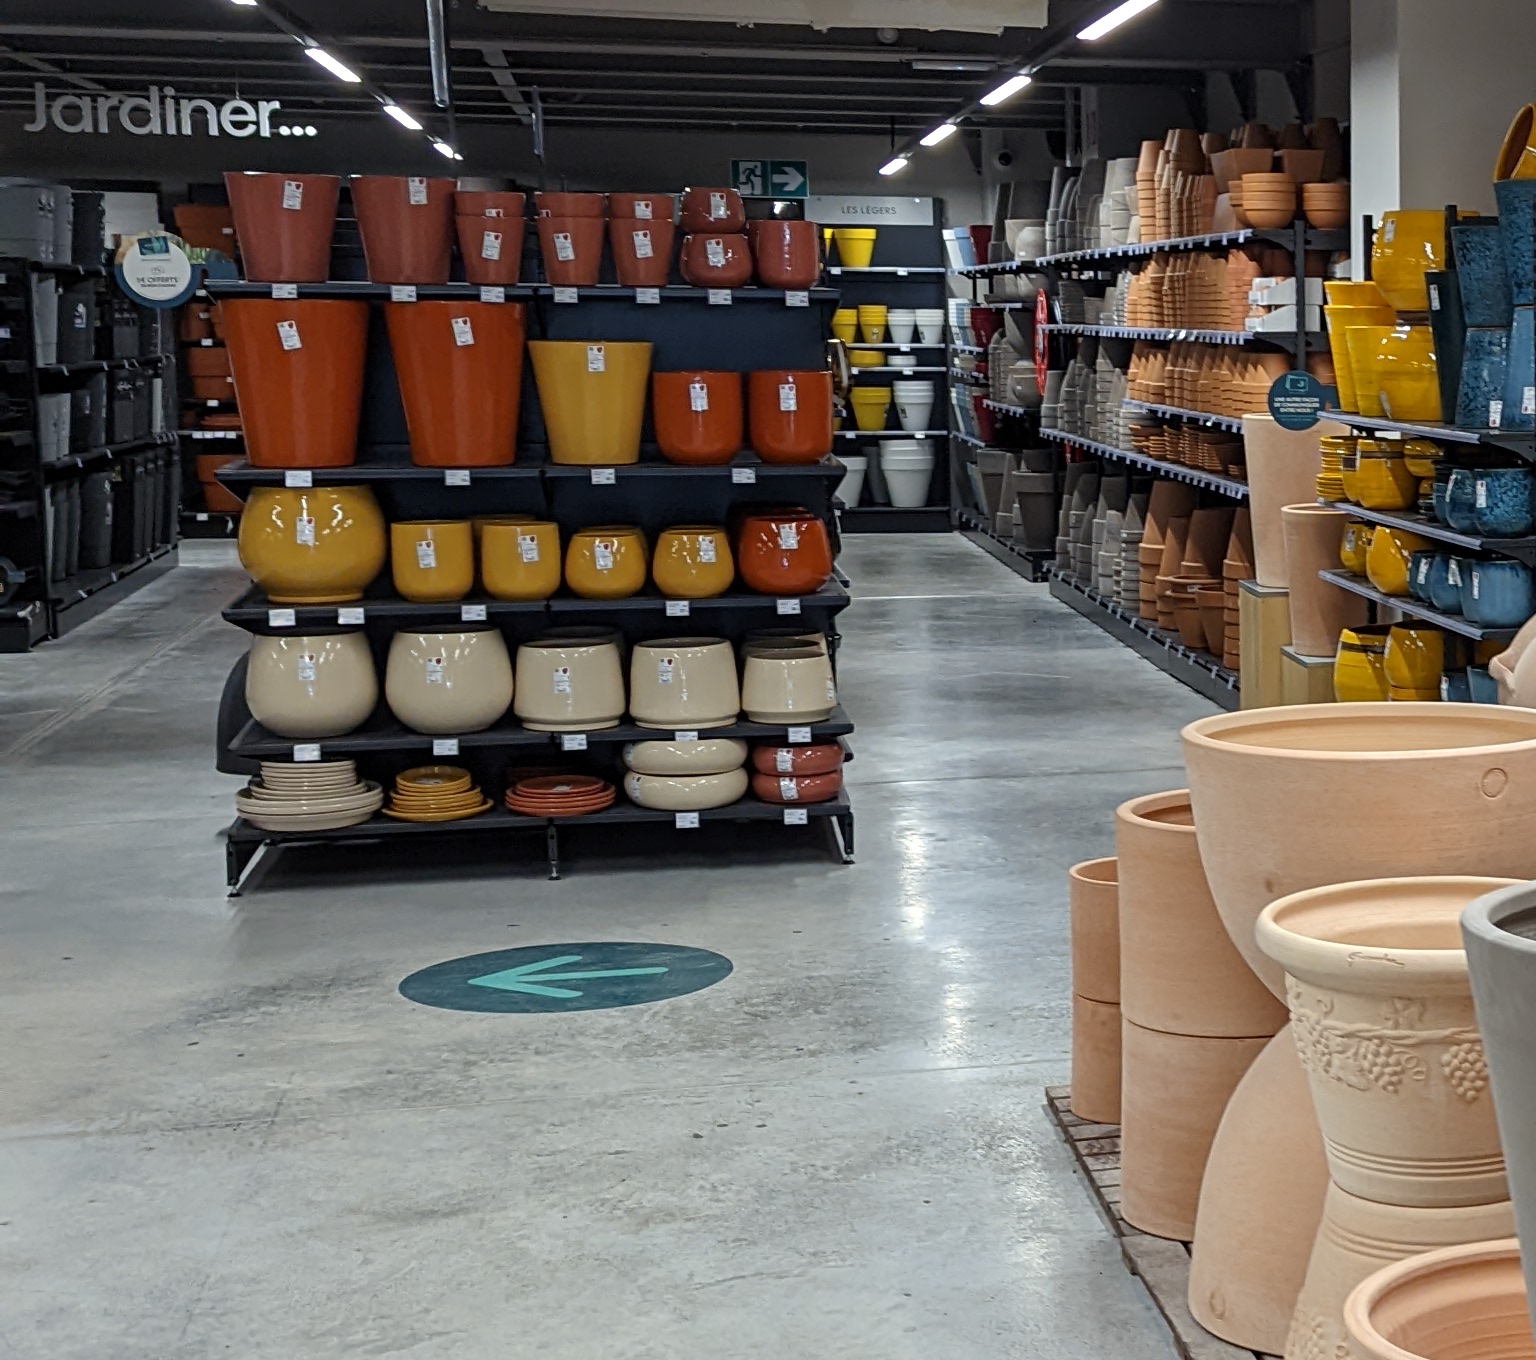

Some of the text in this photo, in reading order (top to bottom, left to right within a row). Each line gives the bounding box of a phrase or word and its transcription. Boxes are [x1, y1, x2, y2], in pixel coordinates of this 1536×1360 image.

[23, 81, 319, 138] Jardiner...
[841, 204, 897, 215] LES LÉGERS
